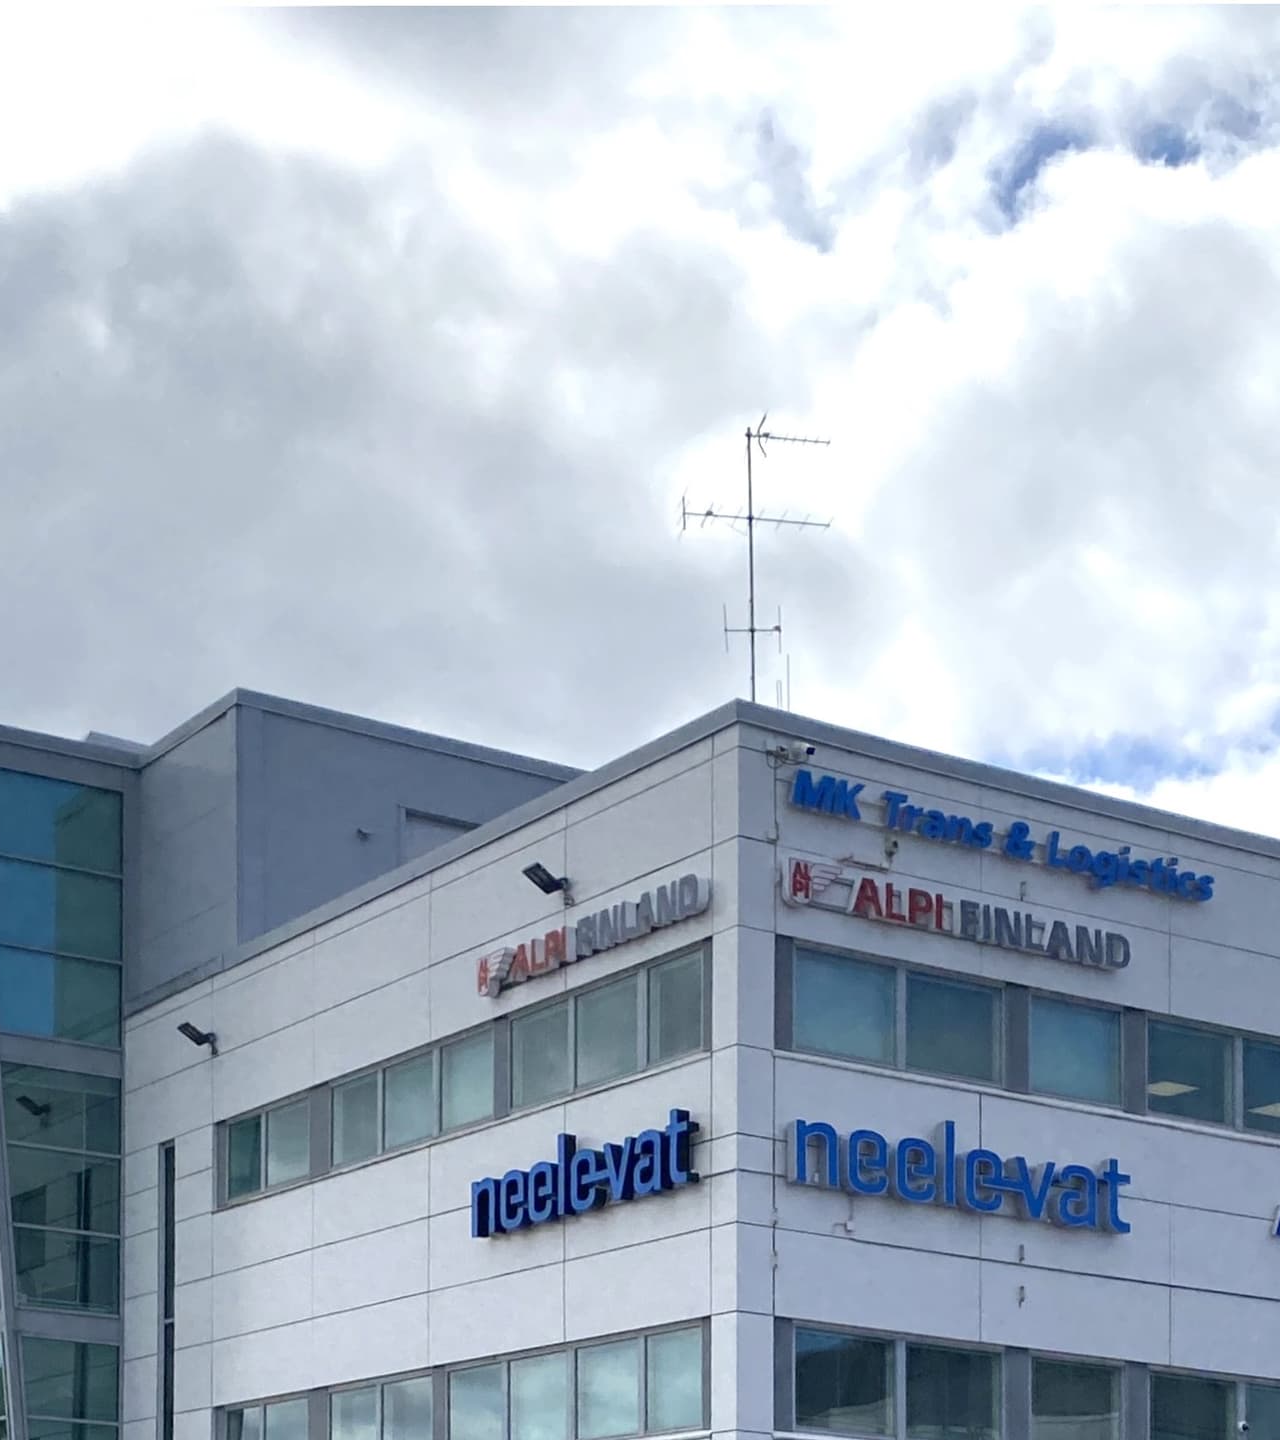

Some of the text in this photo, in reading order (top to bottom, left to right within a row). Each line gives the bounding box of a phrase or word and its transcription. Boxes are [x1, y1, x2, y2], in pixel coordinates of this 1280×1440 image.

[792, 769, 1215, 901] MK Trans & Logistics
[851, 876, 1131, 969] ALPI FINLAND
[471, 1108, 695, 1237] neelevat
[792, 1118, 1131, 1234] neelevat
